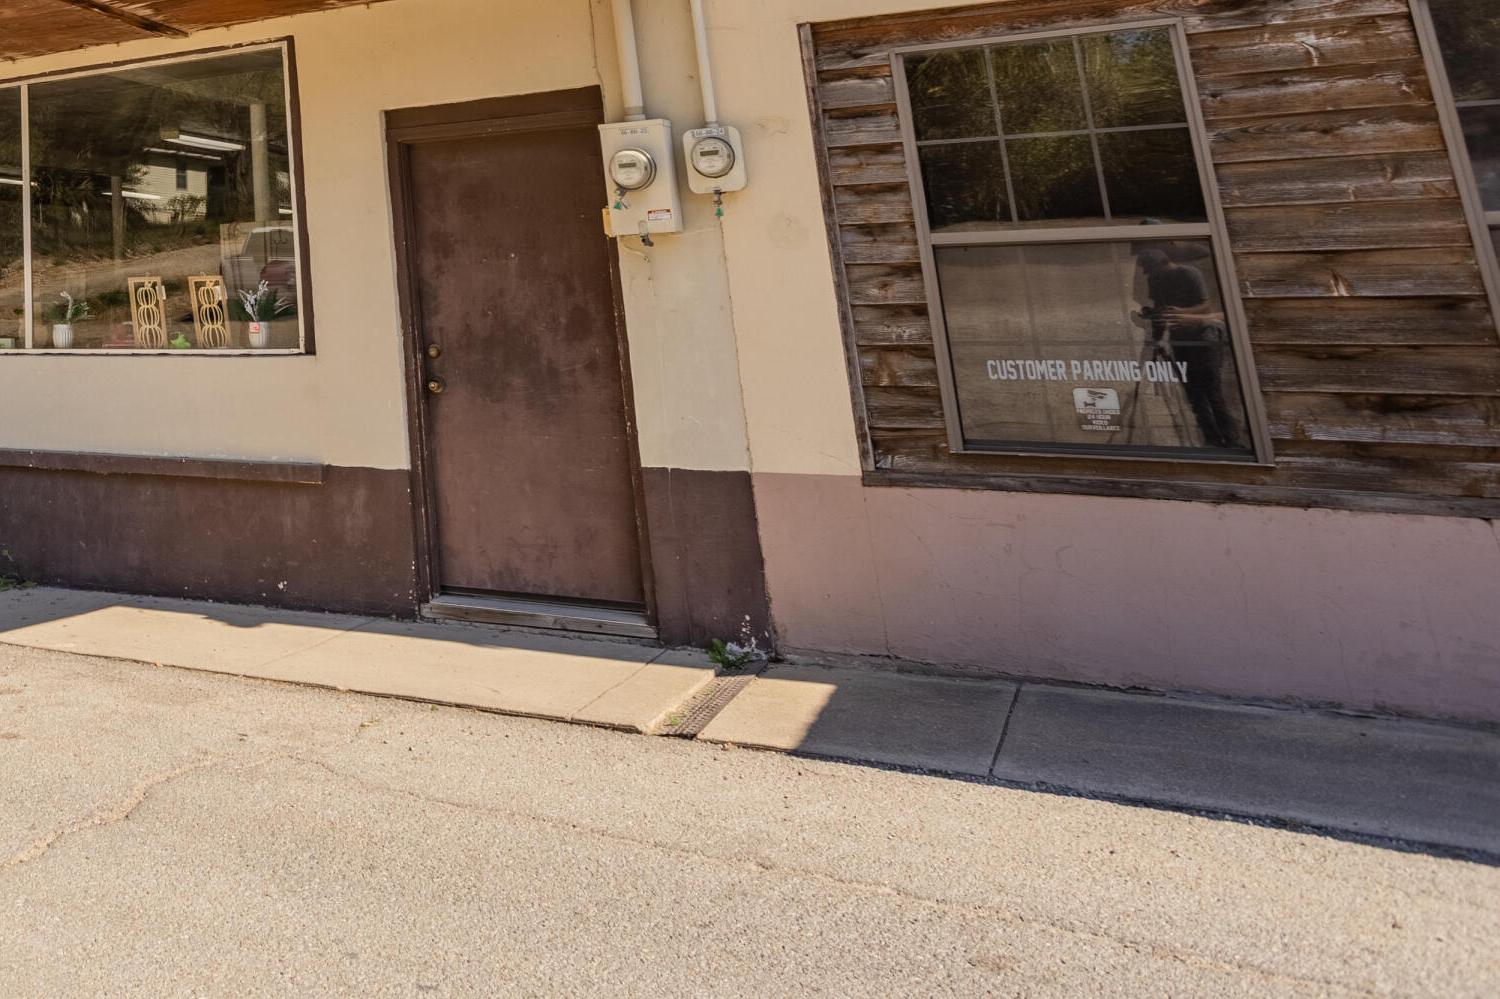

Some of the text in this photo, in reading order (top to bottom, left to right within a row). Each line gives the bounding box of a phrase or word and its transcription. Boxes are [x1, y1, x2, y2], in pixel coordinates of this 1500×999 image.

[986, 359, 1188, 383] CUSTOMER PARKING ONLY
